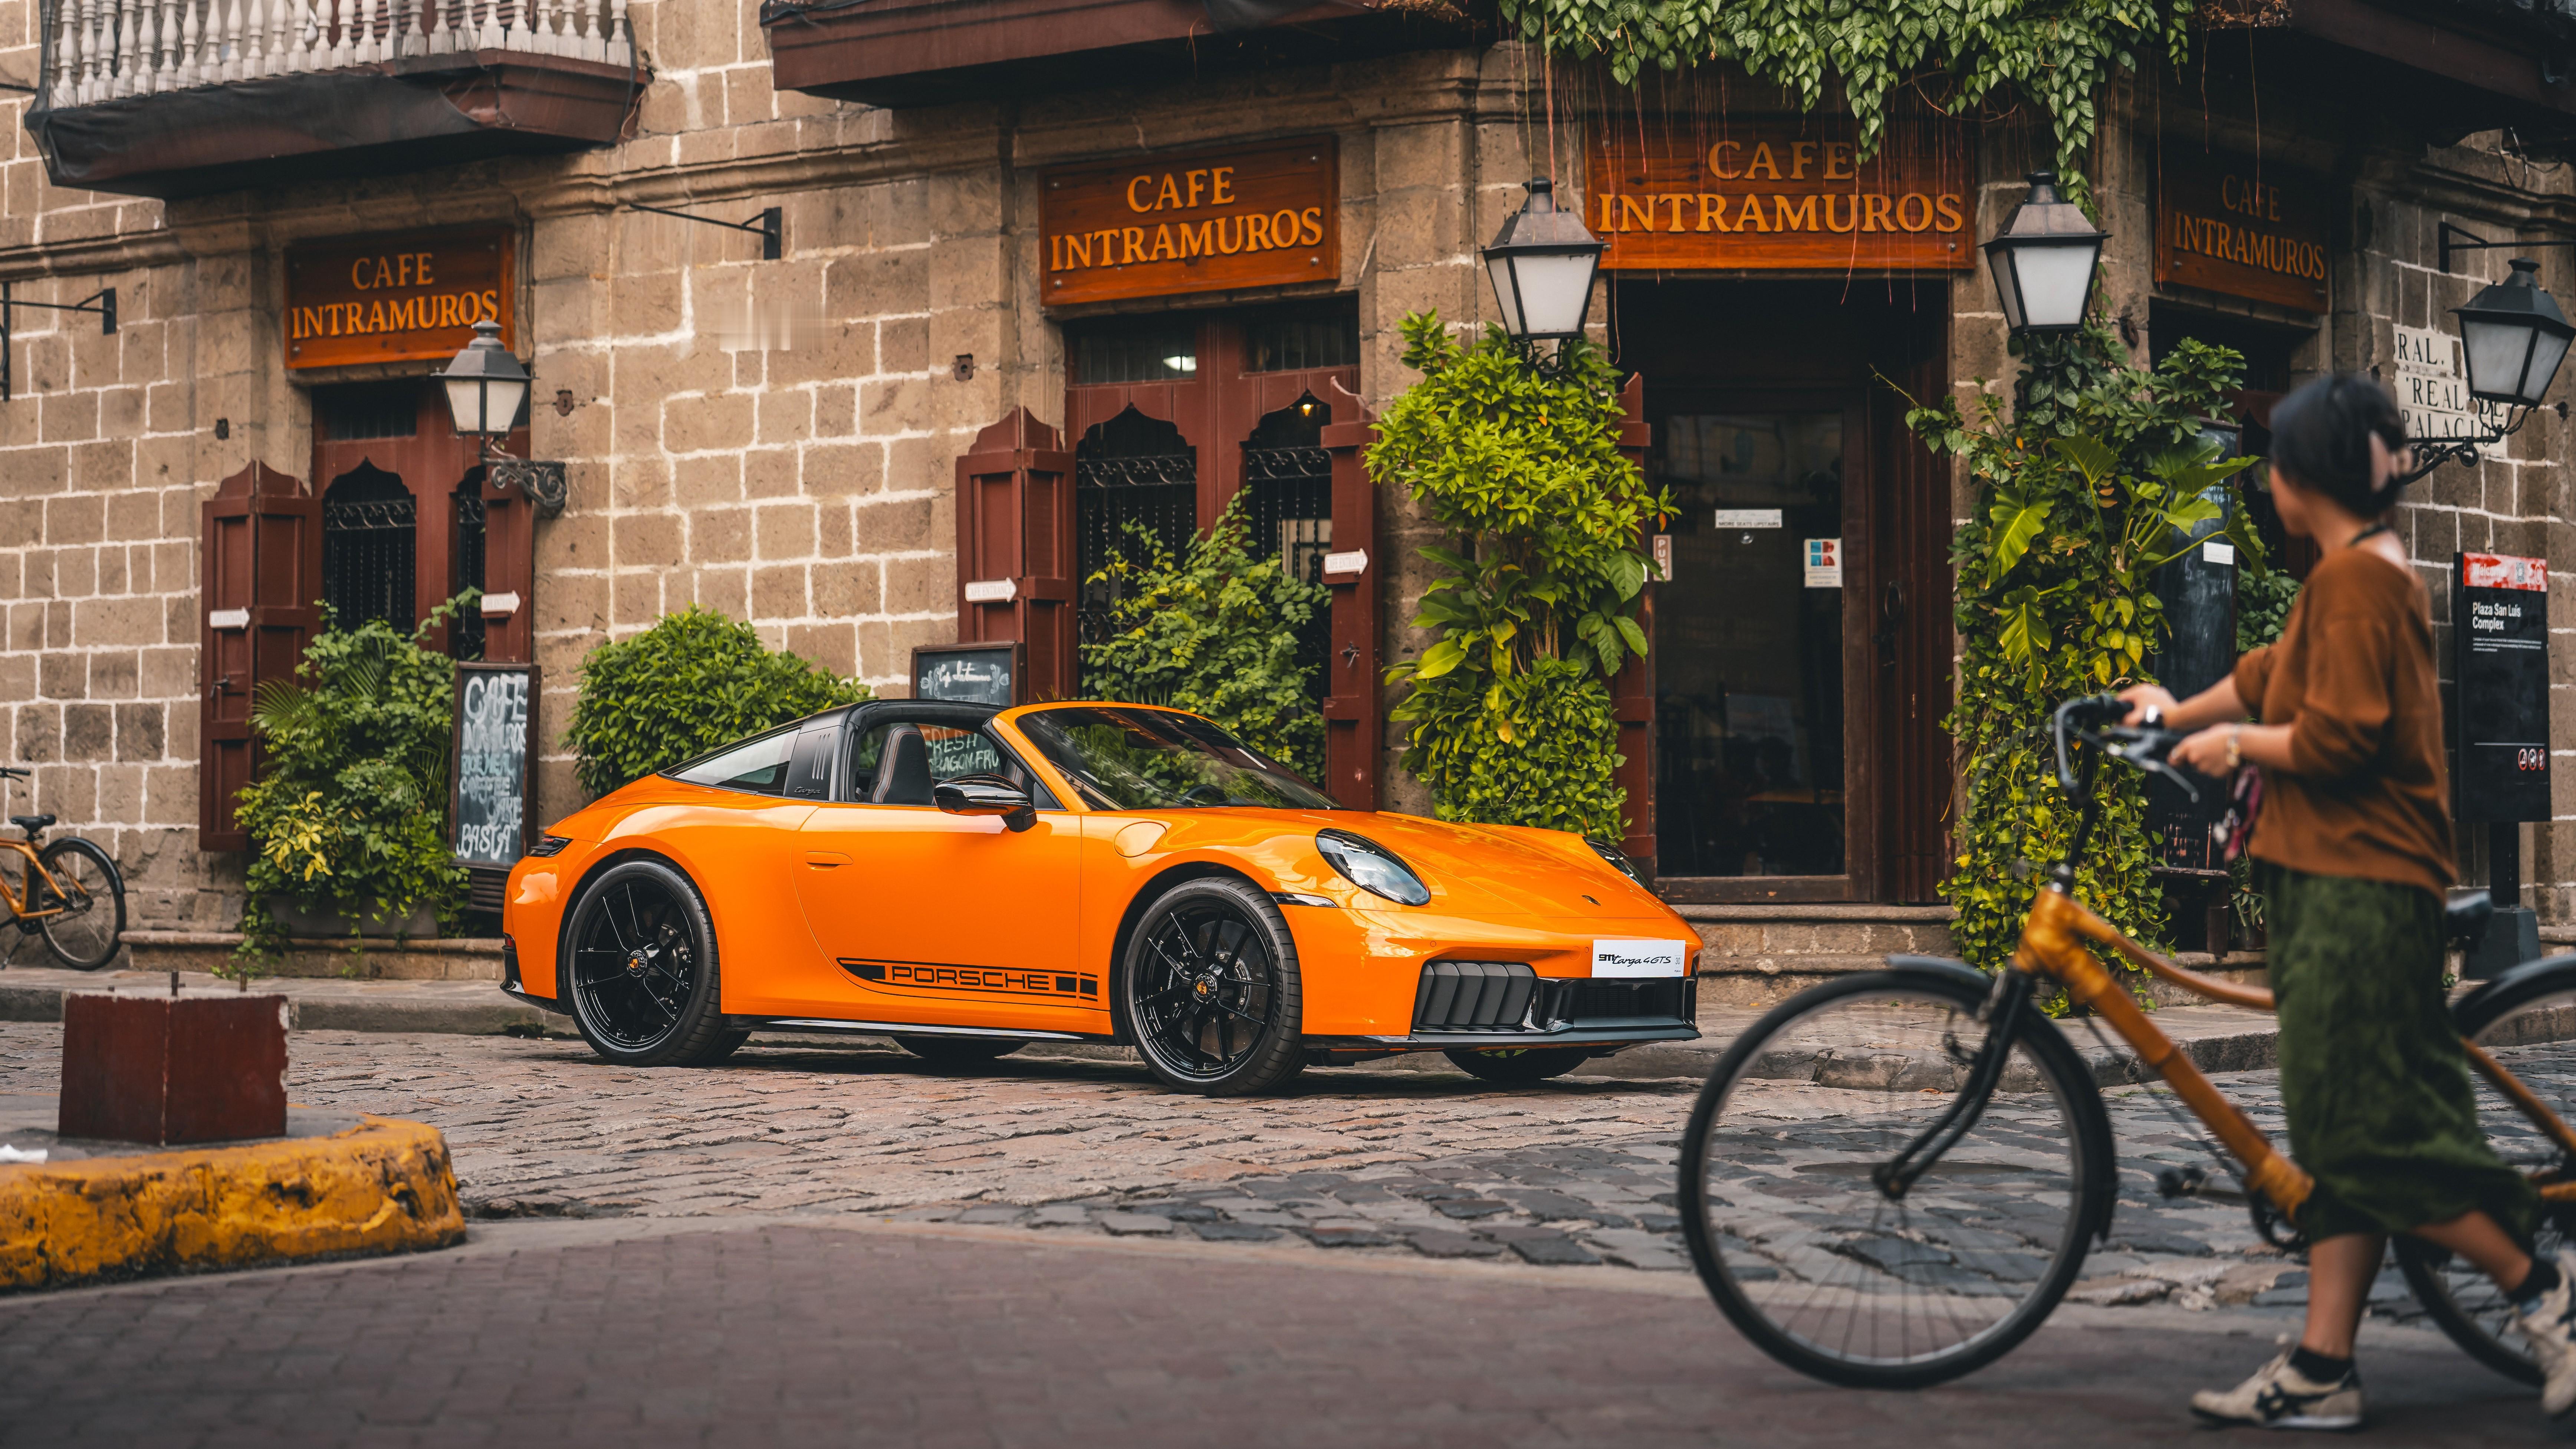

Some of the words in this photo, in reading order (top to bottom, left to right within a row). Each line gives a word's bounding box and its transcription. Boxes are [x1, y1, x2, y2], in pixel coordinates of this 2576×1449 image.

[1708, 140, 1854, 180] CAFE
[1127, 167, 1235, 213] CAFE
[2222, 175, 2280, 222] CAFE
[1598, 193, 1963, 233] INTRAMUROS
[1050, 207, 1324, 271] INTRAMUROS
[2174, 211, 2324, 280] INTRAMUROS
[352, 253, 434, 290] CAFE
[291, 290, 498, 339] INTRAMUROS
[2472, 617, 2504, 632] Complex
[2473, 601, 2493, 615] Plaza
[2494, 602, 2508, 617] San
[2508, 604, 2521, 617] Luis
[464, 673, 528, 724] CAFE
[794, 786, 821, 795] targa
[891, 965, 1049, 991] PORSCHE
[1613, 955, 1642, 967] targa
